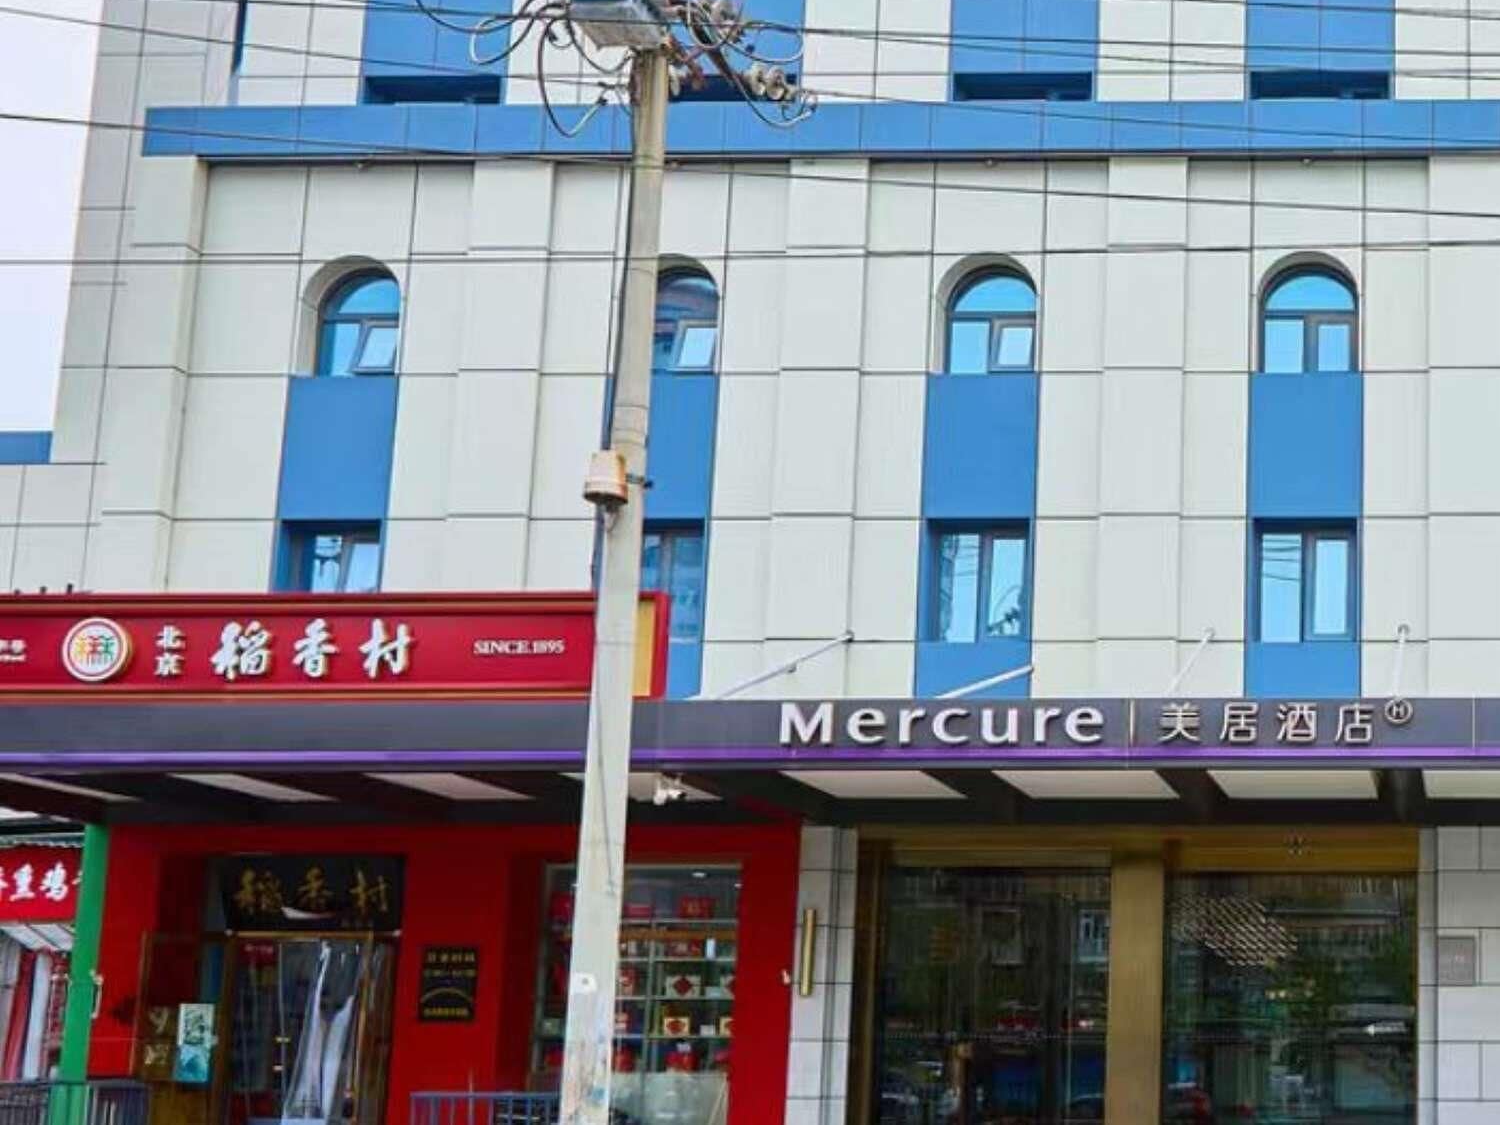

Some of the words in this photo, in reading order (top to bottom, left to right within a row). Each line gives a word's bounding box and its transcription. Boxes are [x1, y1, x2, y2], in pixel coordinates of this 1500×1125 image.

[155, 625, 185, 675] 北京
[211, 618, 414, 681] 稻香村
[779, 703, 1106, 746] Mercure
[1157, 701, 1375, 744] 美居酒店
